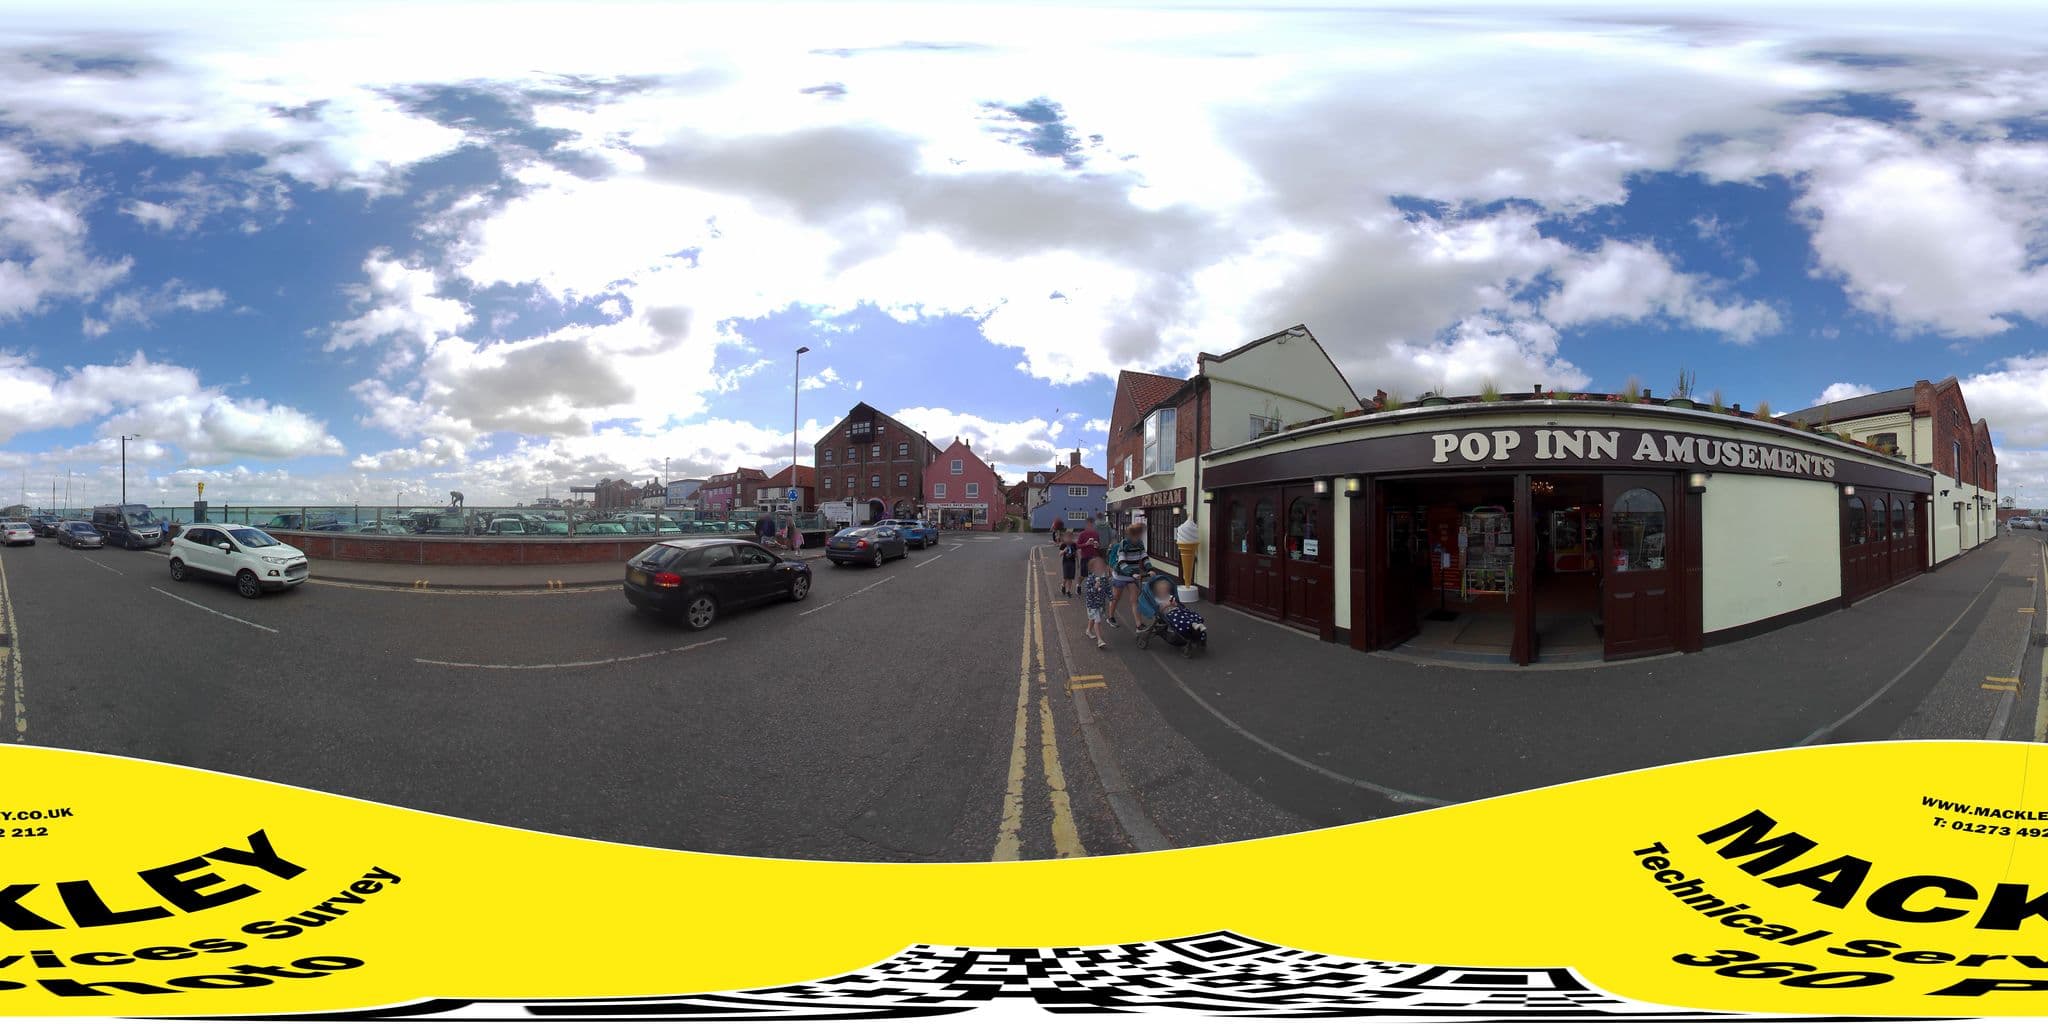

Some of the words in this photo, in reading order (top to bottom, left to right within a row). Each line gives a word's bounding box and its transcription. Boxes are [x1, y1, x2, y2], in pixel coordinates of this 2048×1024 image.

[1431, 429, 1521, 463] POP
[1534, 428, 1621, 460] INN
[1632, 432, 1836, 478] AMUSEMENTS
[1153, 489, 1182, 505] CREAM
